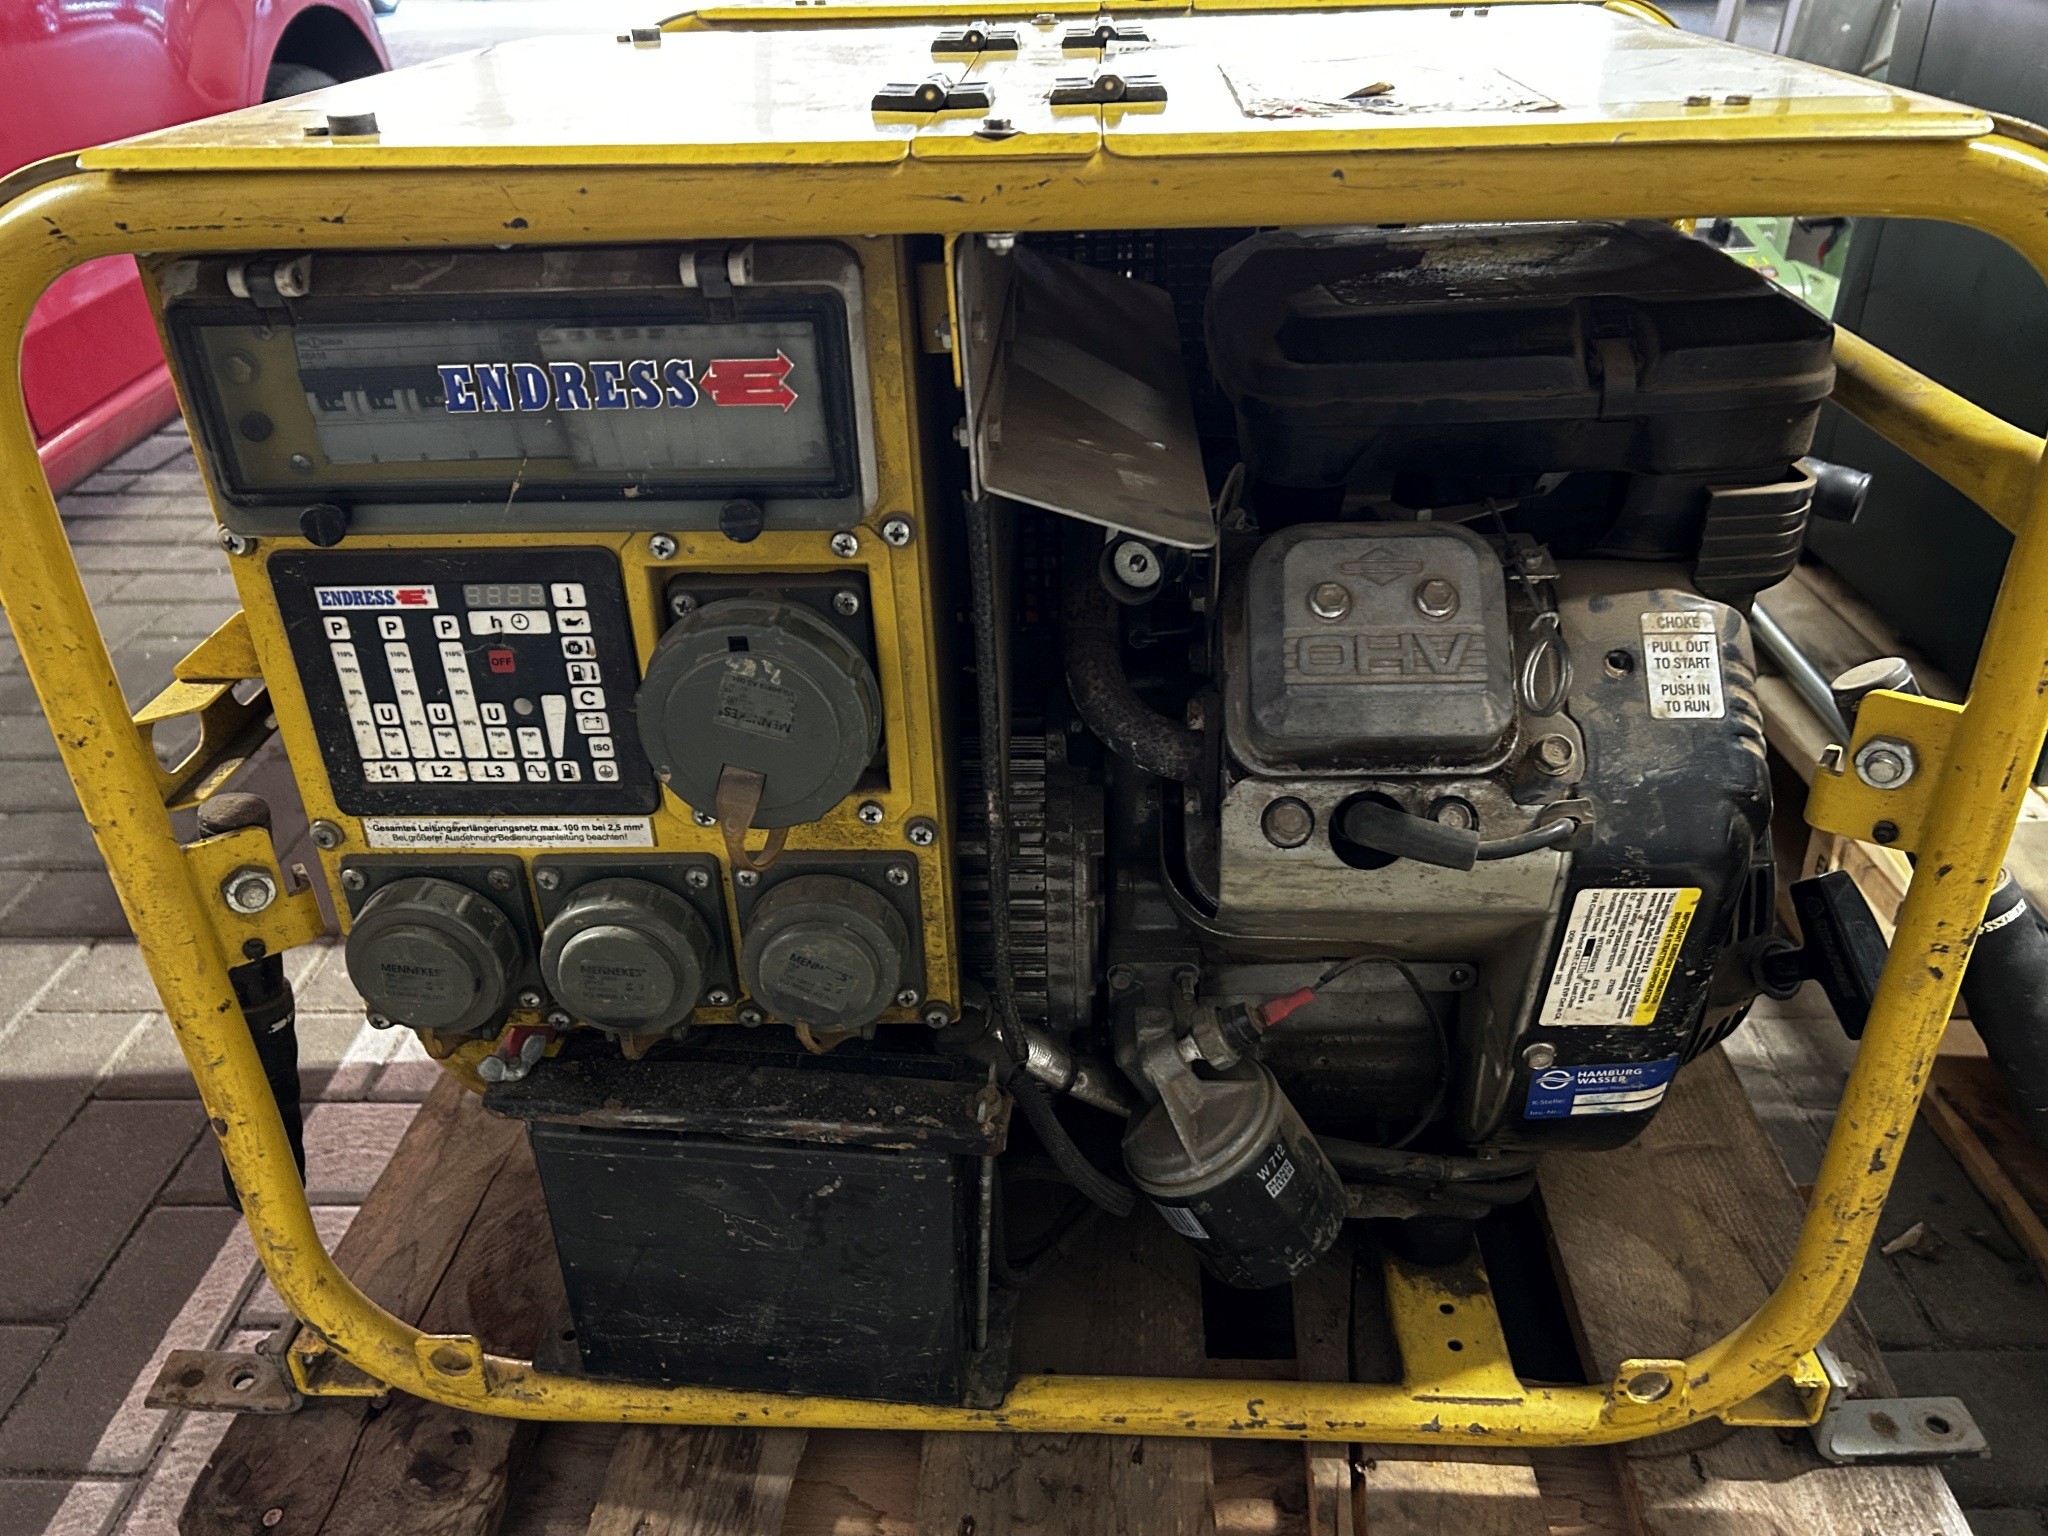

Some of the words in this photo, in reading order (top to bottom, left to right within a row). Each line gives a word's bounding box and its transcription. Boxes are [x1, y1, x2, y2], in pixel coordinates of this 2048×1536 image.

[438, 359, 698, 413] ENDRESS
[319, 589, 396, 606] ENDRESS
[331, 621, 343, 635] P
[385, 621, 397, 635] P
[441, 620, 453, 634] P
[490, 615, 503, 628] h
[1657, 616, 1700, 629] CHOKE
[1298, 632, 1472, 675] OHV
[1652, 641, 1683, 653] PULL
[1686, 641, 1710, 652] OUT
[1654, 657, 1670, 669] TO
[1674, 657, 1710, 669] START
[1661, 684, 1695, 696] PUSH
[1698, 684, 1710, 695] IN
[580, 691, 595, 706] C
[1664, 700, 1681, 712] TO
[1684, 700, 1710, 712] RUN
[380, 708, 393, 721] U
[433, 708, 446, 721] U
[487, 708, 500, 721] U
[380, 766, 399, 778] L1
[431, 766, 453, 778] L2
[484, 766, 505, 778] L3
[373, 824, 416, 832] Gesamtes
[541, 824, 561, 832] max.
[1577, 1068, 1643, 1078] HAMBURG
[1577, 1076, 1627, 1085] WASSER
[1256, 1164, 1270, 1181] W
[1268, 1144, 1286, 1168] 712
[1267, 1160, 1291, 1191] MANN
